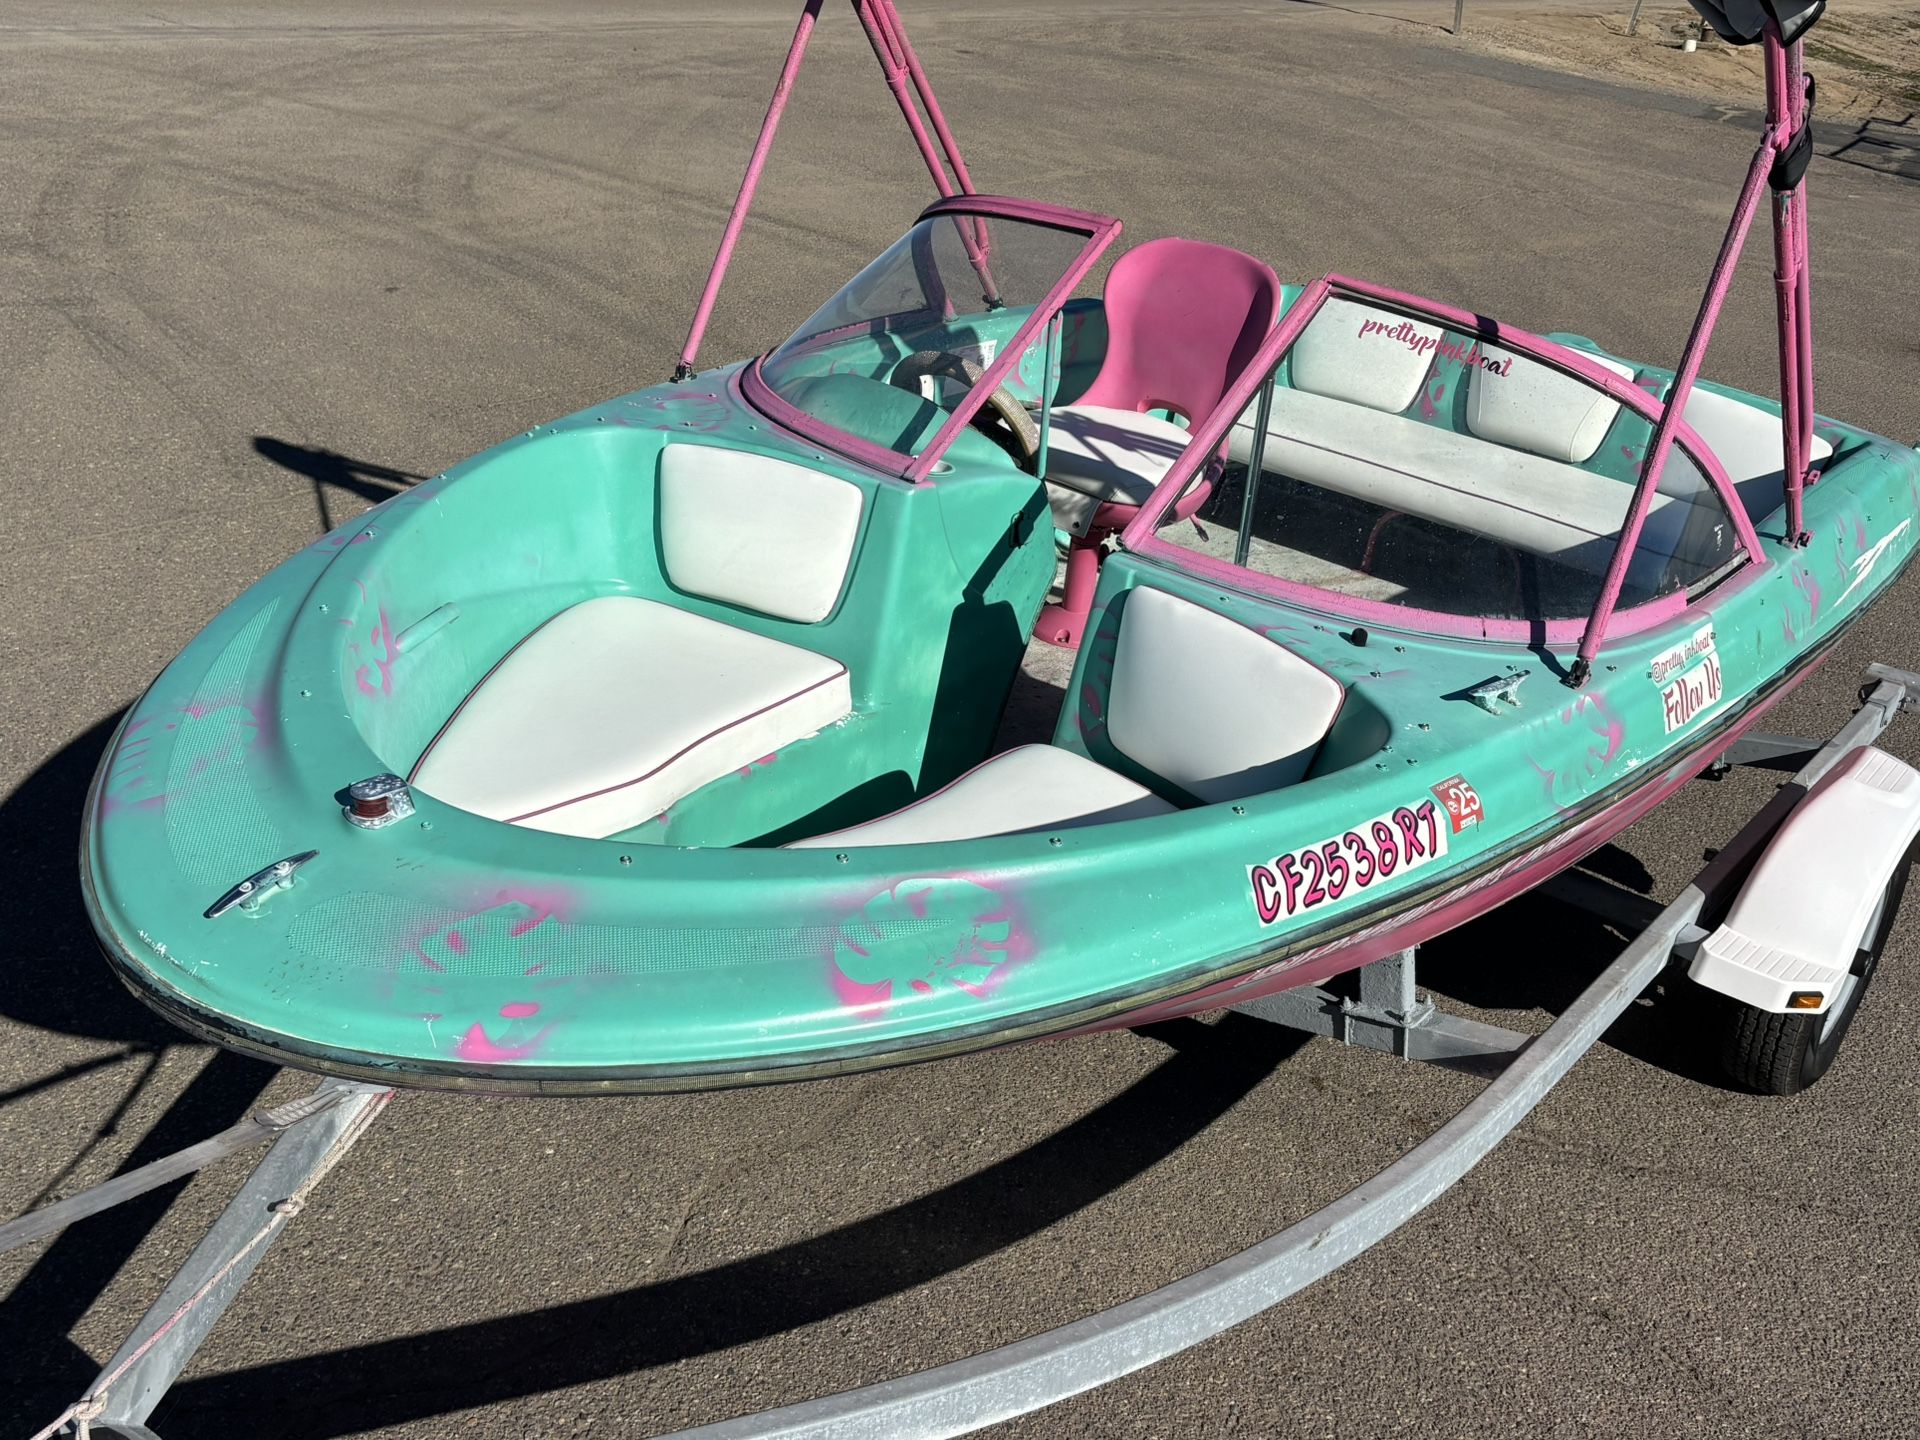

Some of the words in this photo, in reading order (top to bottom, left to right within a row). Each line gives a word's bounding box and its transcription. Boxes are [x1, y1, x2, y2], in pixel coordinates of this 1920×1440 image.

[1358, 319, 1513, 377] prettypinkboat
[1663, 678, 1703, 731] Follow
[1703, 656, 1721, 700] Us
[1448, 782, 1480, 816] 25
[1252, 800, 1435, 923] CF2538RT
